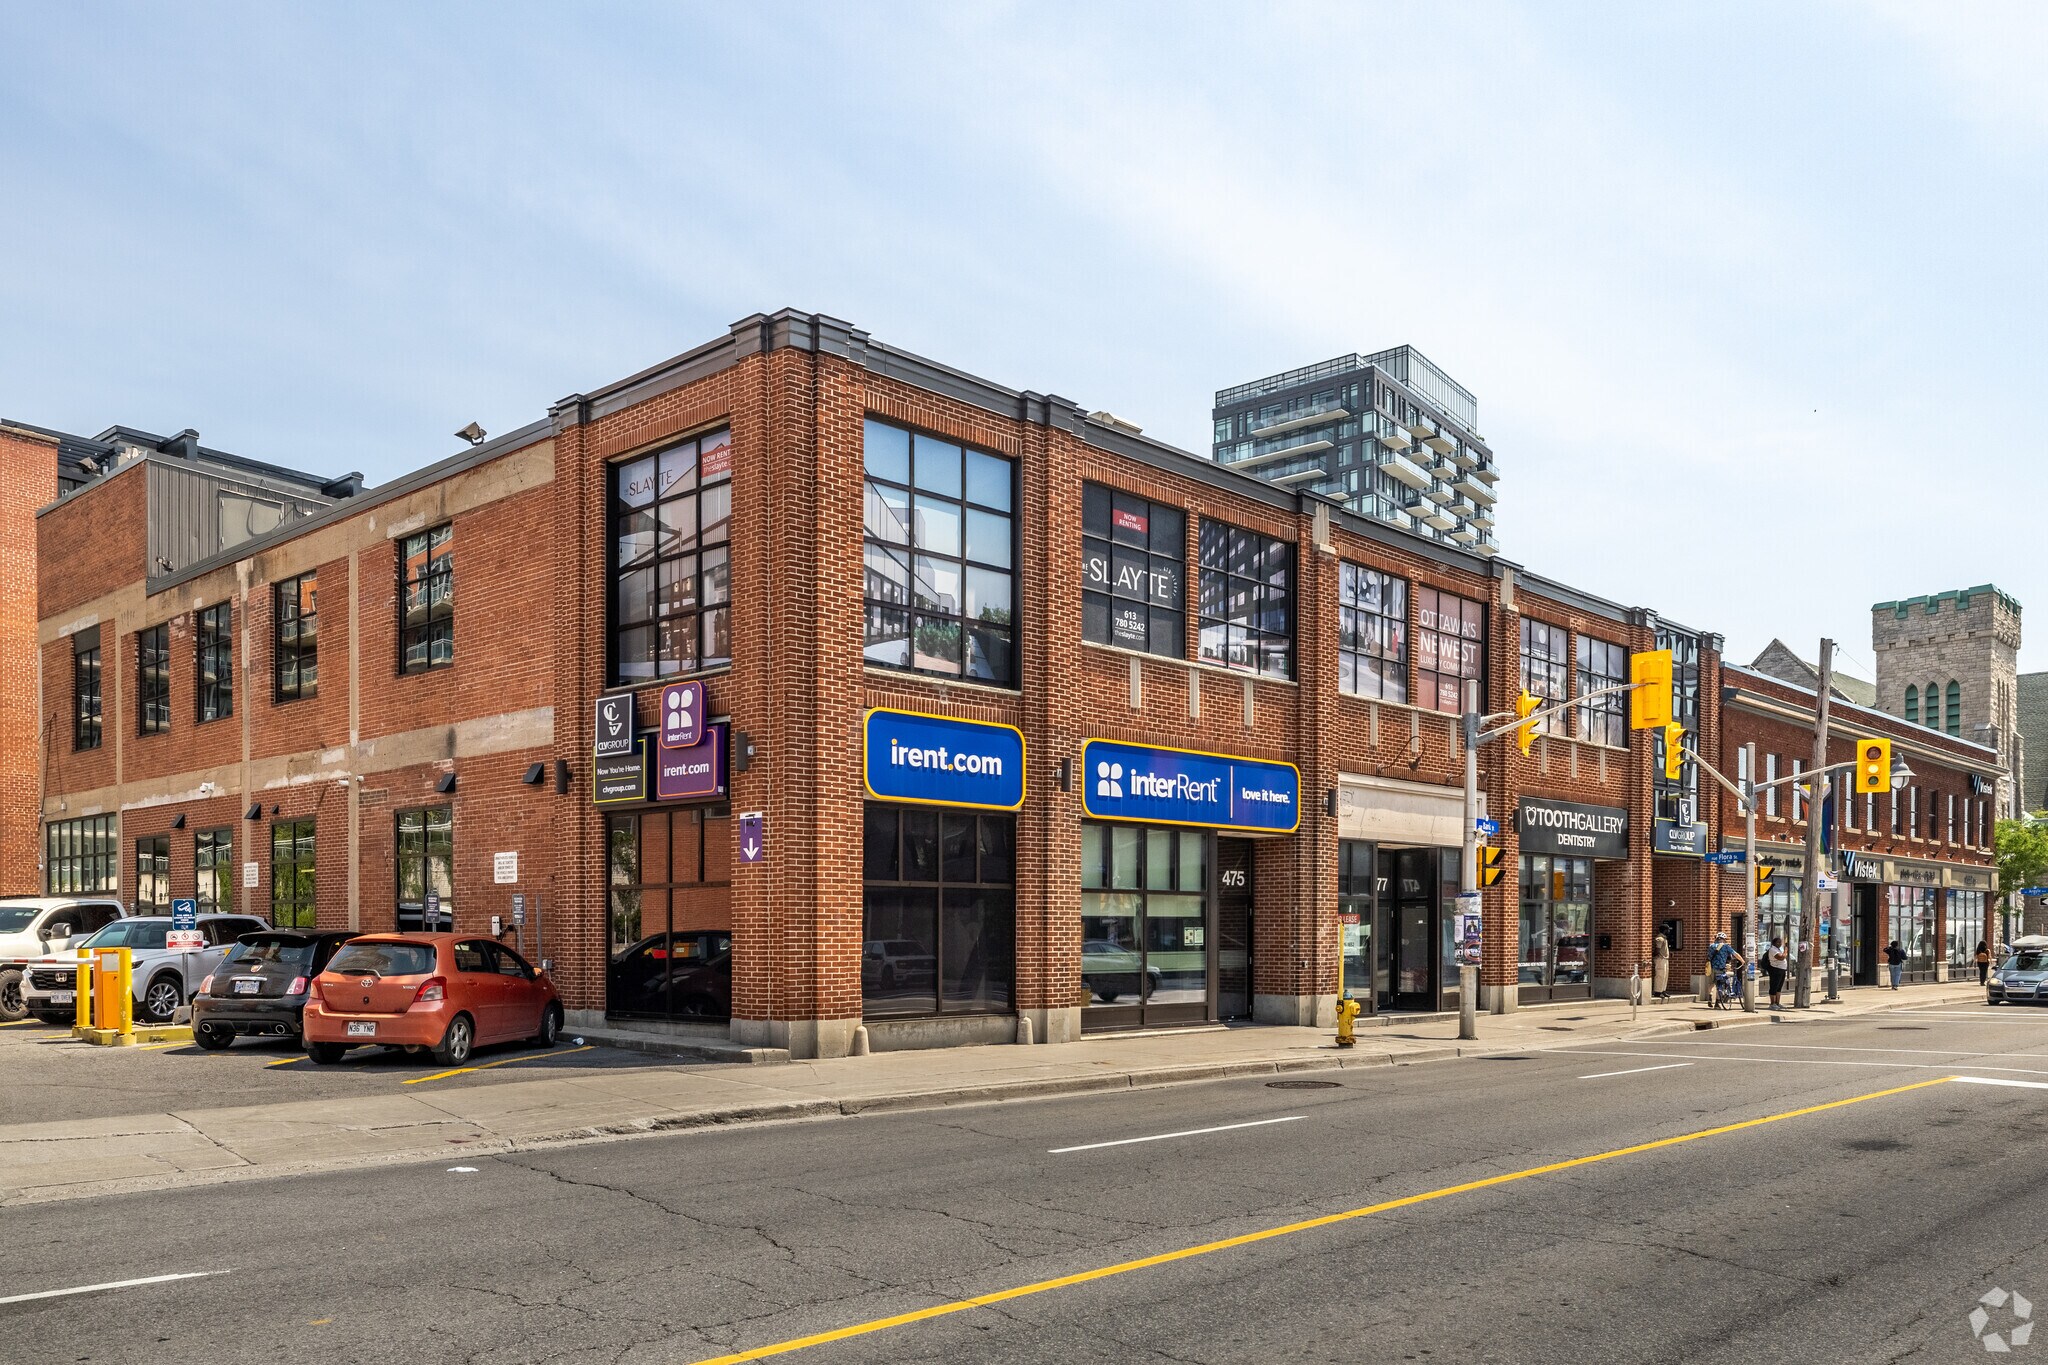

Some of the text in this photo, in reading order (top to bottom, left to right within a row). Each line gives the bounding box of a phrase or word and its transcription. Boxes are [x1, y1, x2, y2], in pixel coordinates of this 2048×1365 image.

[702, 453, 716, 464] NOW
[629, 469, 673, 497] SLAYTE
[1118, 518, 1142, 531] RENTING
[1123, 513, 1137, 522] NOW
[1089, 557, 1169, 598] SLAYTE
[1123, 610, 1137, 620] 613
[1115, 617, 1145, 632] 780 5242
[1420, 608, 1477, 639] OTTAWA'S
[1420, 631, 1477, 663] NEWEST
[891, 738, 1002, 776] irent.com
[597, 764, 641, 776] Now You're Home.
[664, 763, 709, 777] irent.com
[602, 784, 636, 794] clvgroup.com
[1242, 787, 1261, 801] love
[1261, 789, 1269, 802] it
[1557, 833, 1596, 848] DENTISTRY
[1854, 860, 1878, 878] Vistek
[1222, 870, 1245, 887] 475
